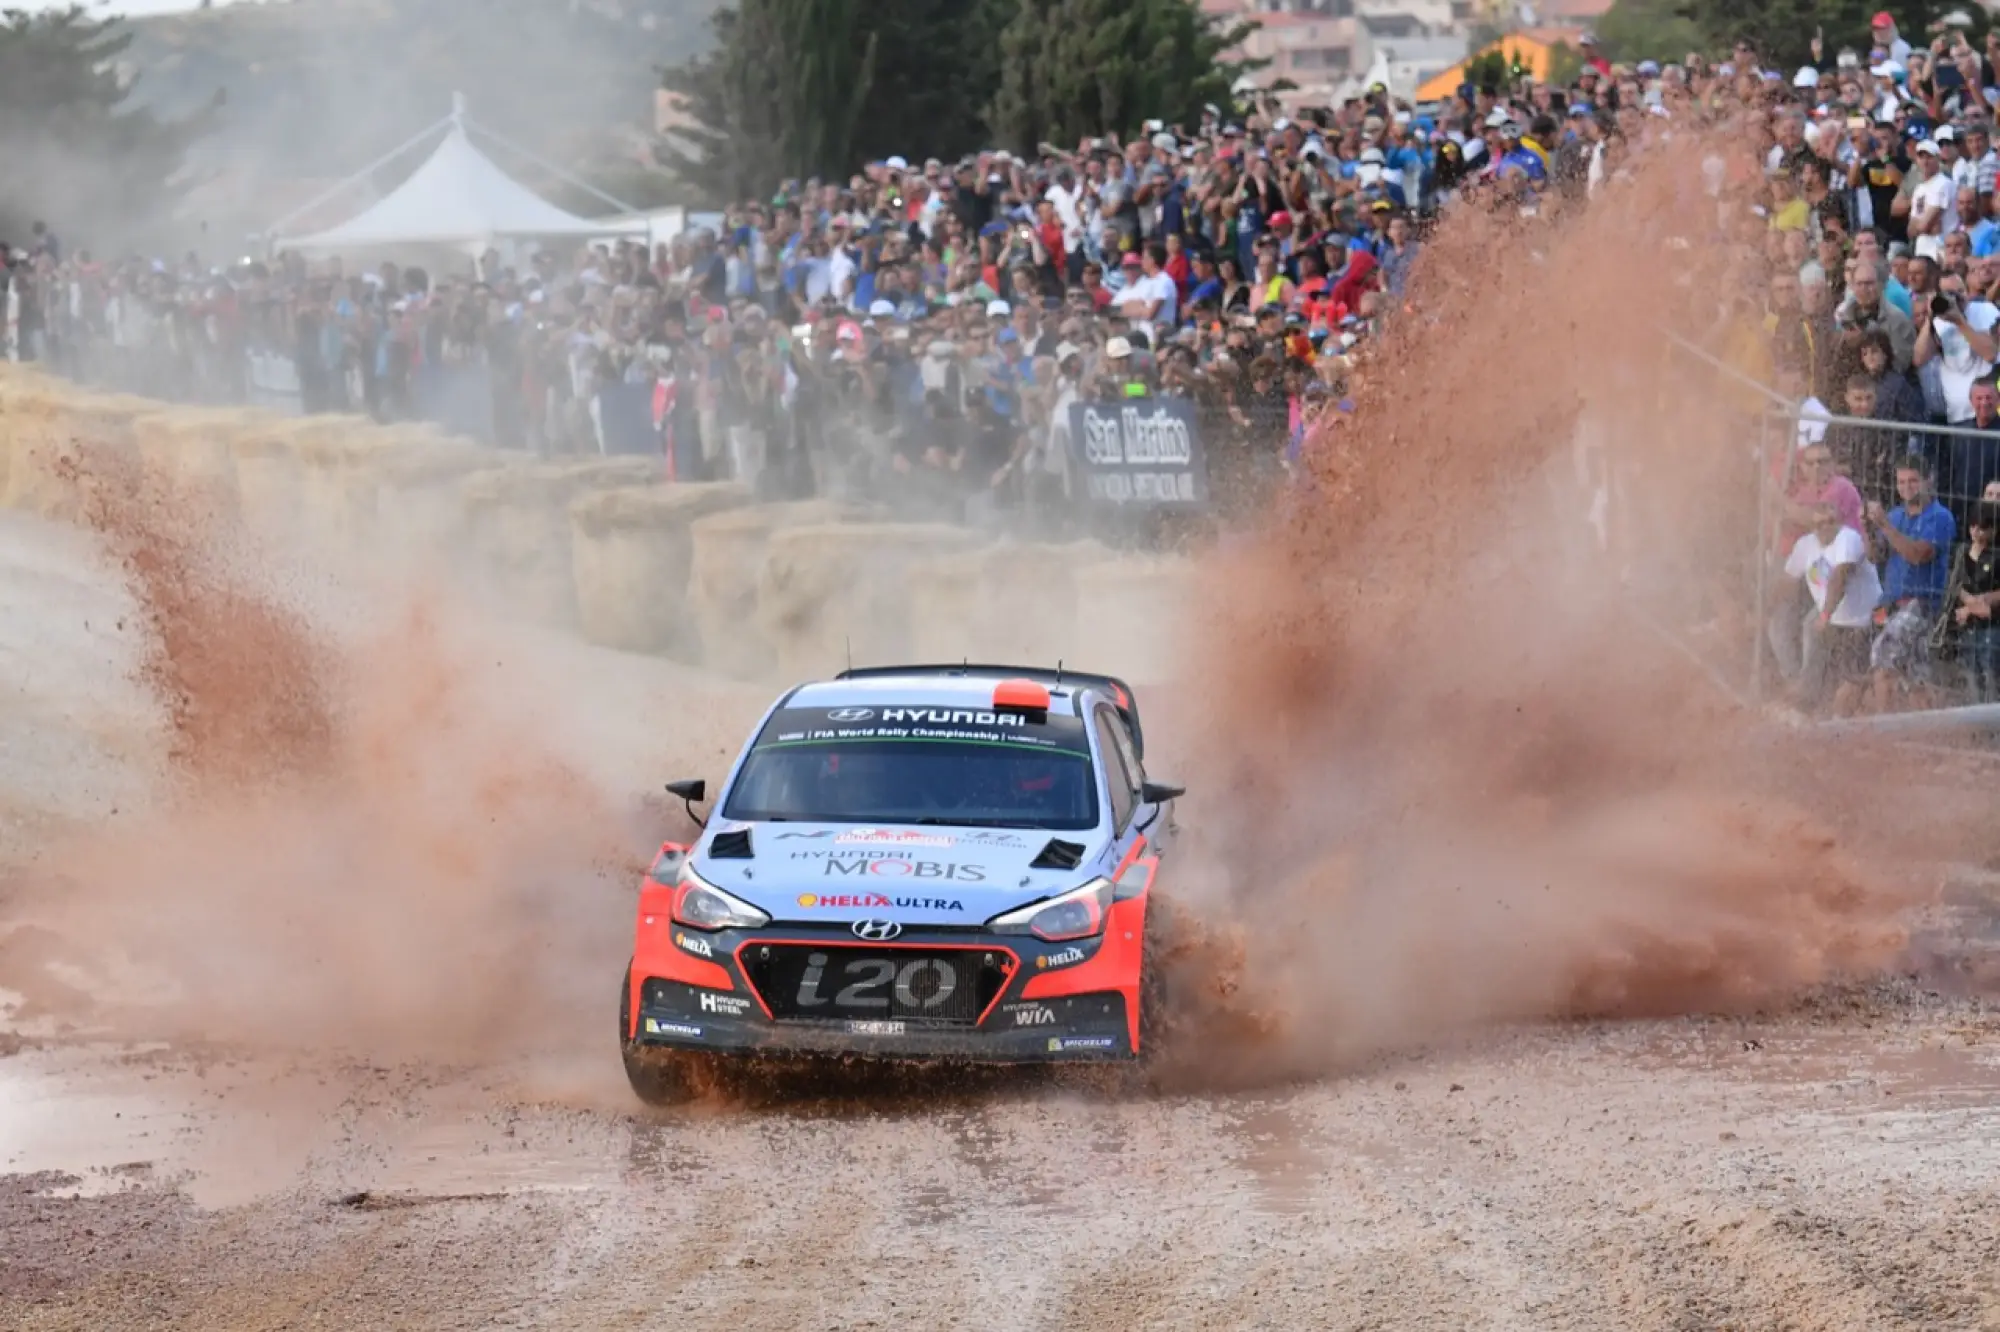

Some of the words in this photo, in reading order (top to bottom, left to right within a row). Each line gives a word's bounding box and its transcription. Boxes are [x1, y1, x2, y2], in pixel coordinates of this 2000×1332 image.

[1084, 408, 1122, 465] San
[1122, 405, 1191, 465] Martino
[882, 708, 1026, 727] HYUNDAI
[814, 730, 835, 738] FIA
[838, 729, 875, 738] World
[877, 728, 908, 738] Rally
[911, 728, 999, 741] Championship
[790, 849, 913, 861] HYUNDAI
[824, 857, 986, 882] MOBIS
[819, 892, 894, 907] HELIX
[895, 896, 964, 911] ULTRA
[682, 936, 713, 957] HELIX
[1047, 946, 1084, 967] HELIX
[796, 952, 957, 1009] i20
[1016, 1006, 1056, 1025] WIA
[1063, 1037, 1112, 1047] MICHELIN
